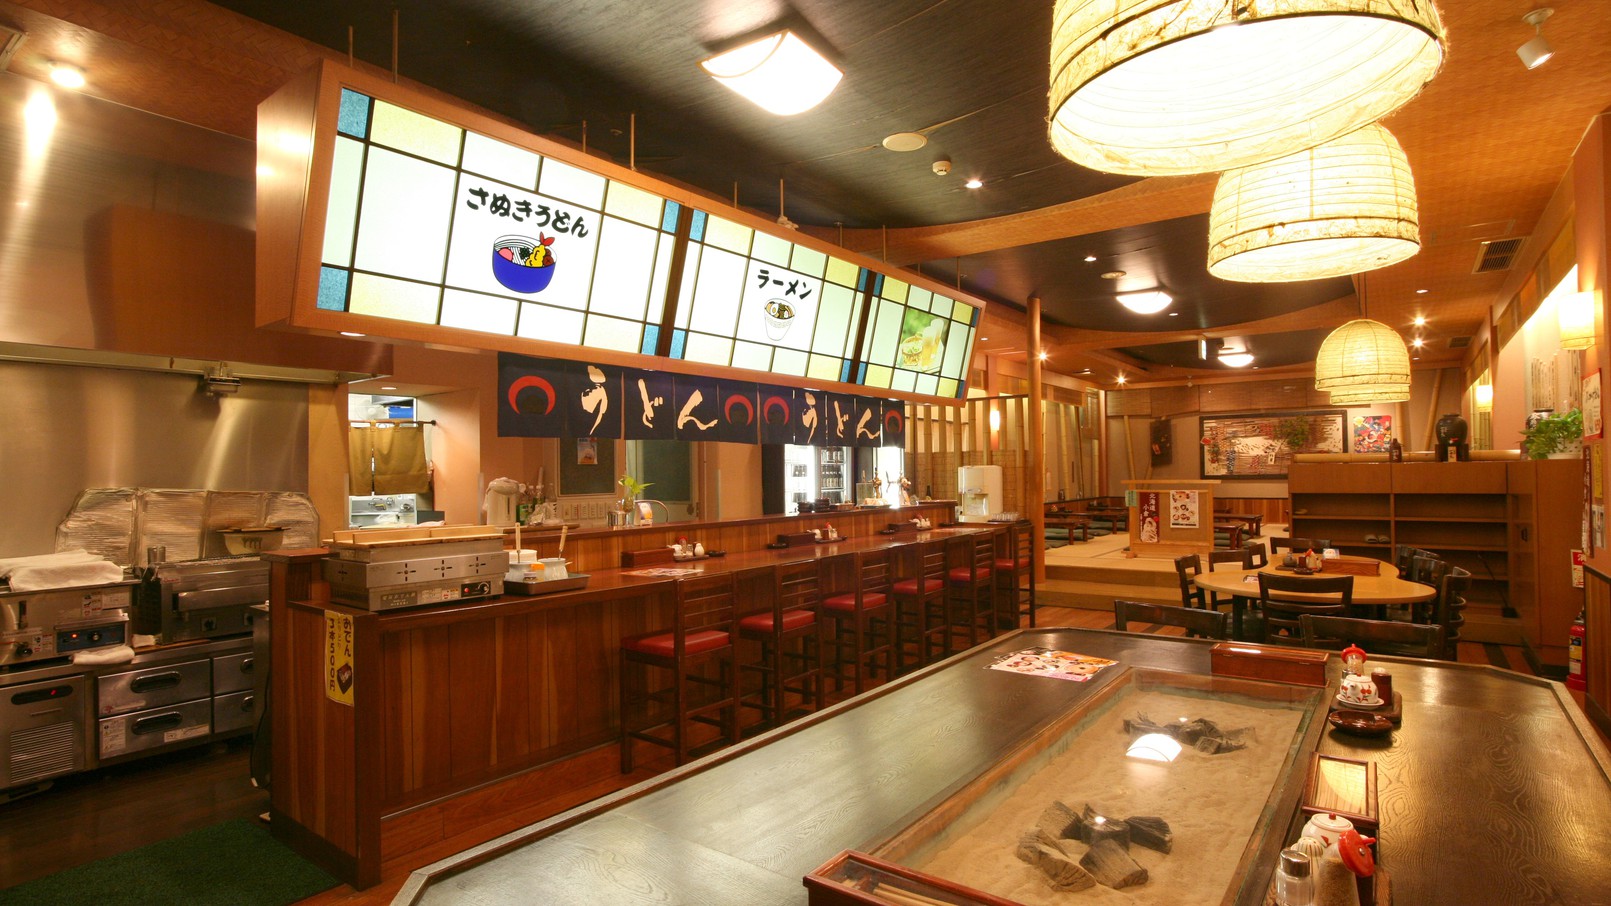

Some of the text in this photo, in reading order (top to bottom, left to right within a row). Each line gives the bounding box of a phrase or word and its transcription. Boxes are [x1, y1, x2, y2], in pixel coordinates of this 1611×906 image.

[466, 187, 589, 238] さぬきうどん
[757, 269, 812, 300] ラーメン
[581, 365, 719, 435] うどん
[802, 391, 880, 444] うどん
[343, 617, 351, 657] おでん
